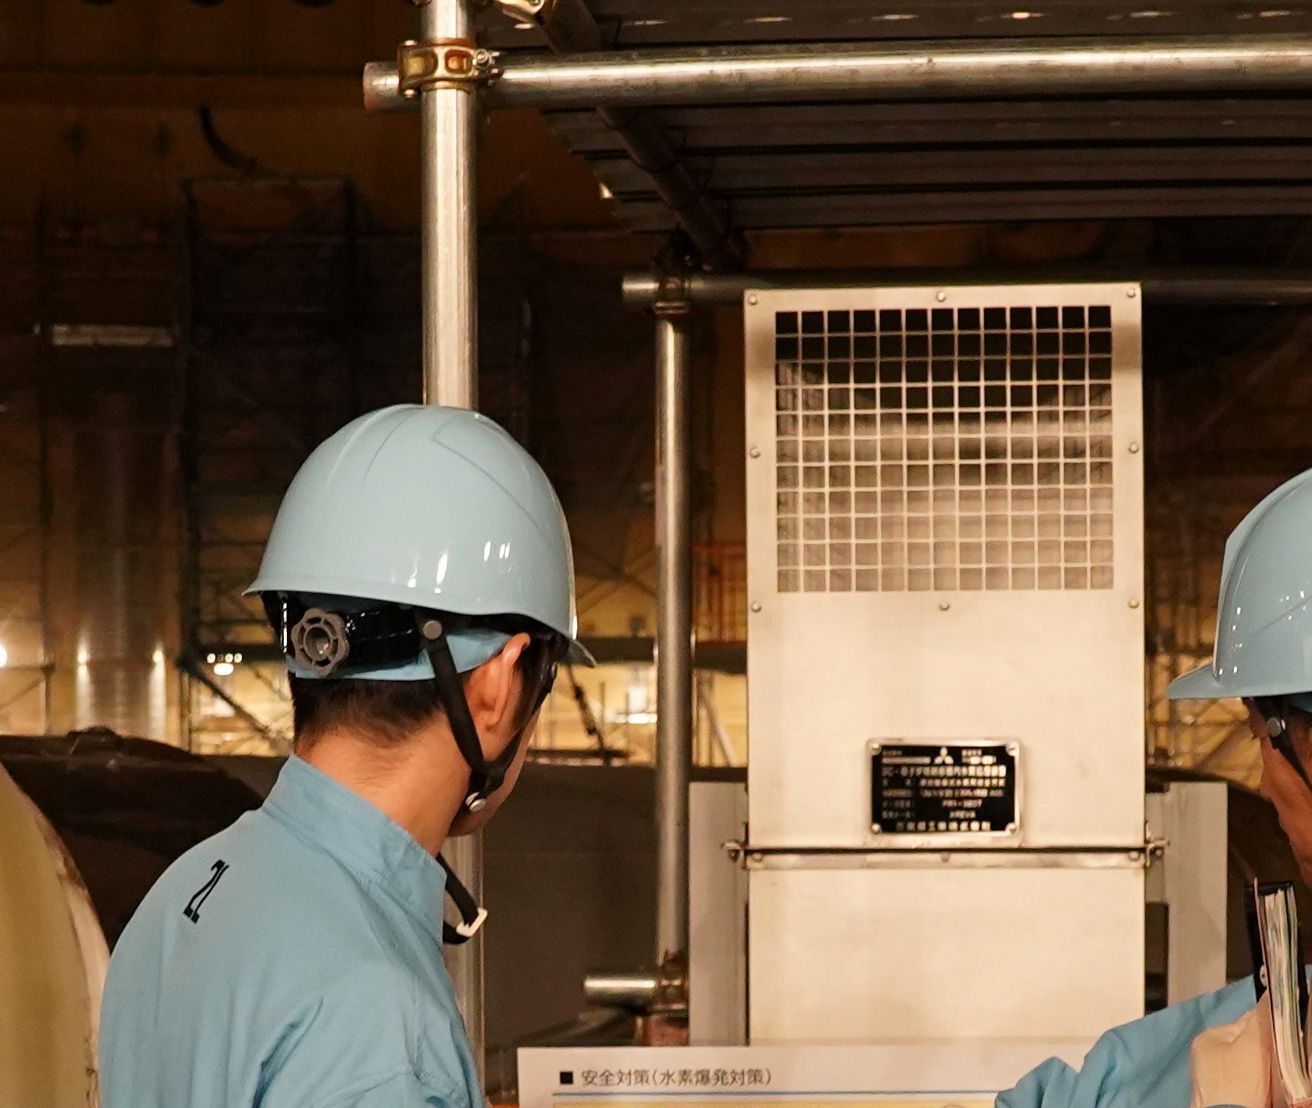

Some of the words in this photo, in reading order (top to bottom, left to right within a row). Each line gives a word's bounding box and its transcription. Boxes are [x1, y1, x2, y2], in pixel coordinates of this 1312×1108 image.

[581, 1068, 772, 1087] 安全対策(水素爆発対策)
